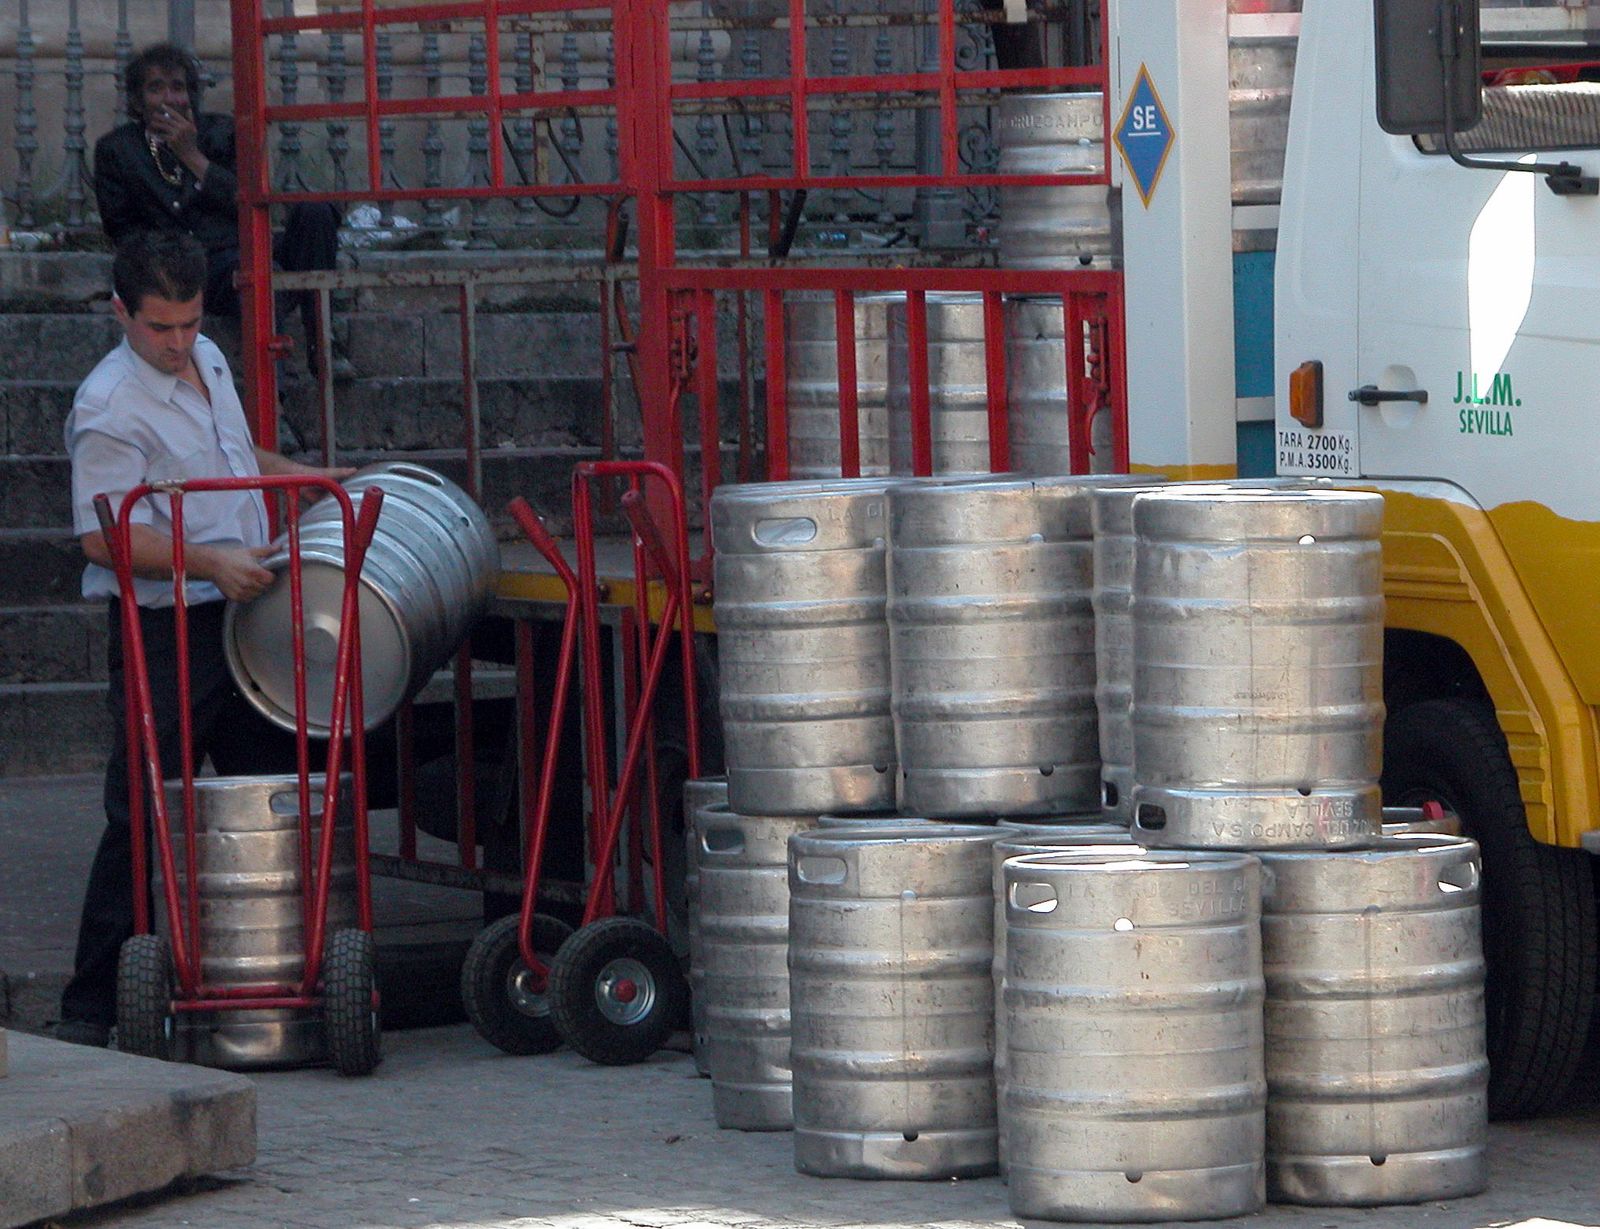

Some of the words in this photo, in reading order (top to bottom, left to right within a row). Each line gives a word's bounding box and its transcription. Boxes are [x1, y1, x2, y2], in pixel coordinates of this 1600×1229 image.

[1132, 105, 1156, 130] SE
[1453, 371, 1522, 407] J.L.M.
[1459, 409, 1514, 437] SEVILLA
[1279, 431, 1303, 448] TARA
[1307, 434, 1337, 451] 2700
[1280, 451, 1307, 468] P.M.A.
[1307, 452, 1337, 470] 3500
[1284, 799, 1353, 819] SEVILLA
